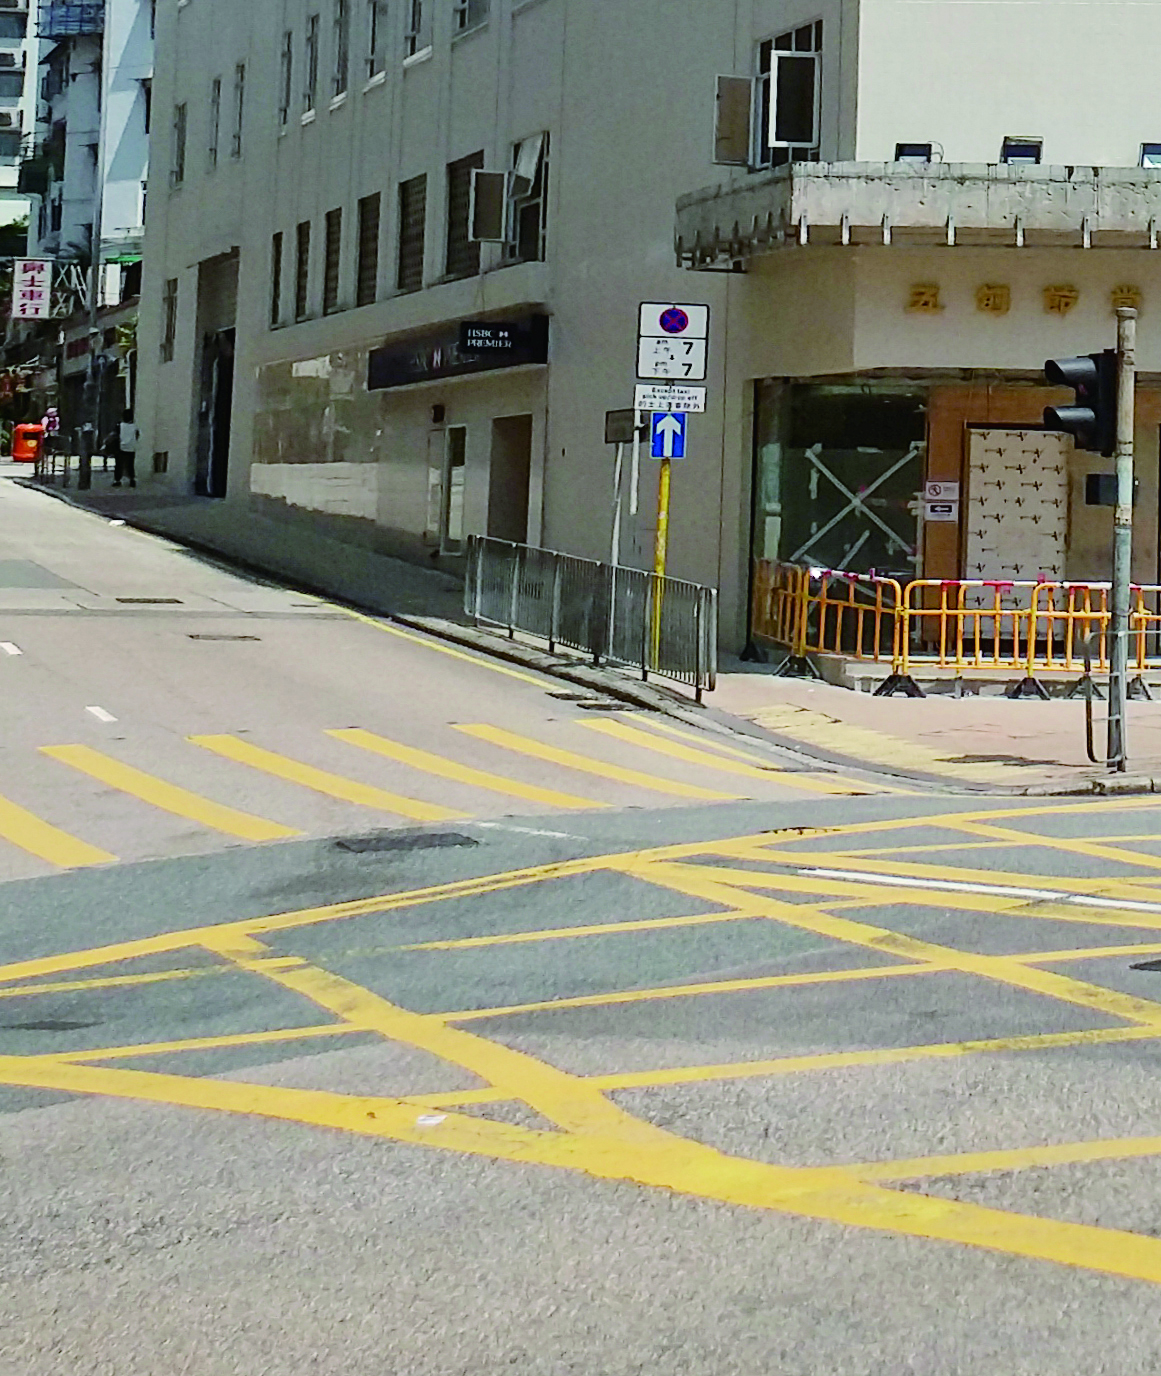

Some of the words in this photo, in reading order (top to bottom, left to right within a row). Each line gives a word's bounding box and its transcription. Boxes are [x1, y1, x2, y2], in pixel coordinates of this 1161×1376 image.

[468, 329, 494, 338] HSBC
[467, 339, 512, 348] PREMIER
[683, 341, 694, 355] 7
[681, 363, 693, 376] 7
